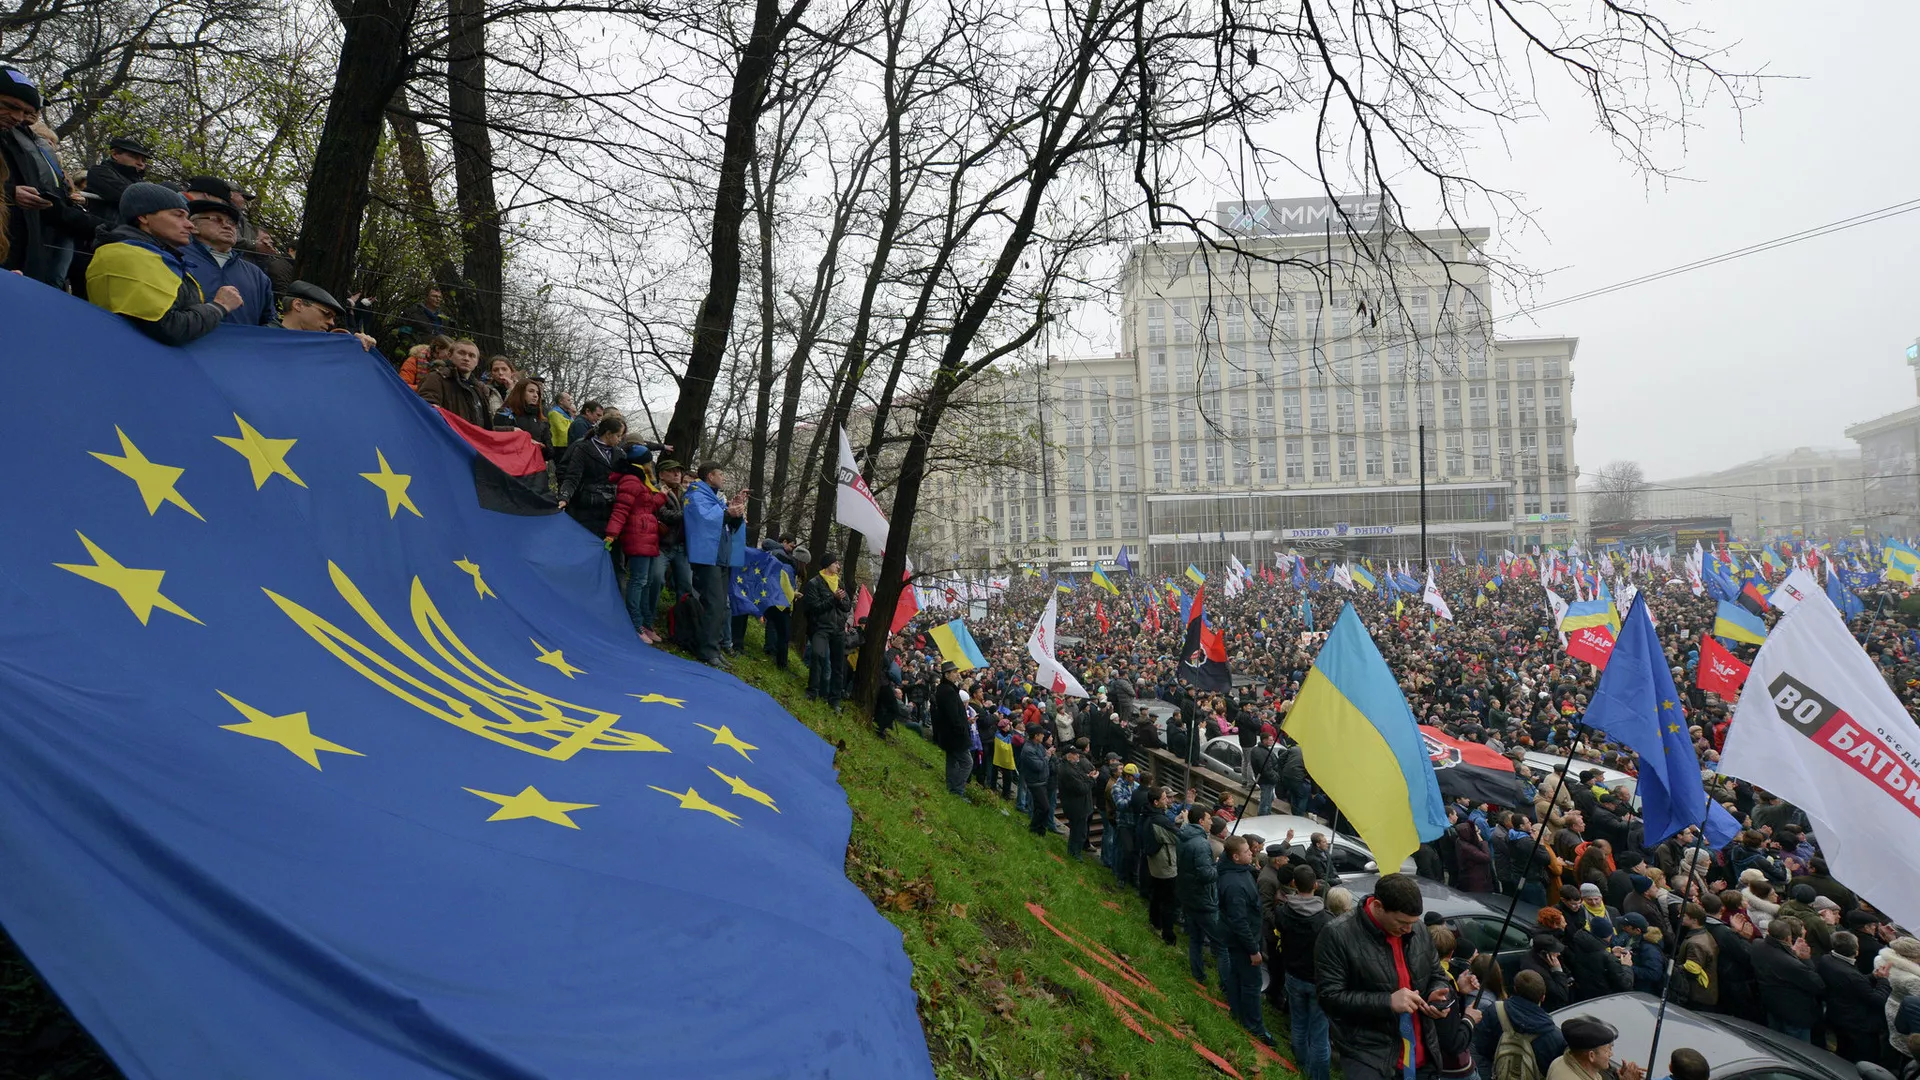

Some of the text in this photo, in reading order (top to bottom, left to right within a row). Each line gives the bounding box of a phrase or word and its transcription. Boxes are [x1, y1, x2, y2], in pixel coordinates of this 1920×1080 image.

[1292, 528, 1330, 538] DNIPRO
[1774, 684, 1822, 724] ВО
[1877, 727, 1920, 771] ОБ'ЄДН
